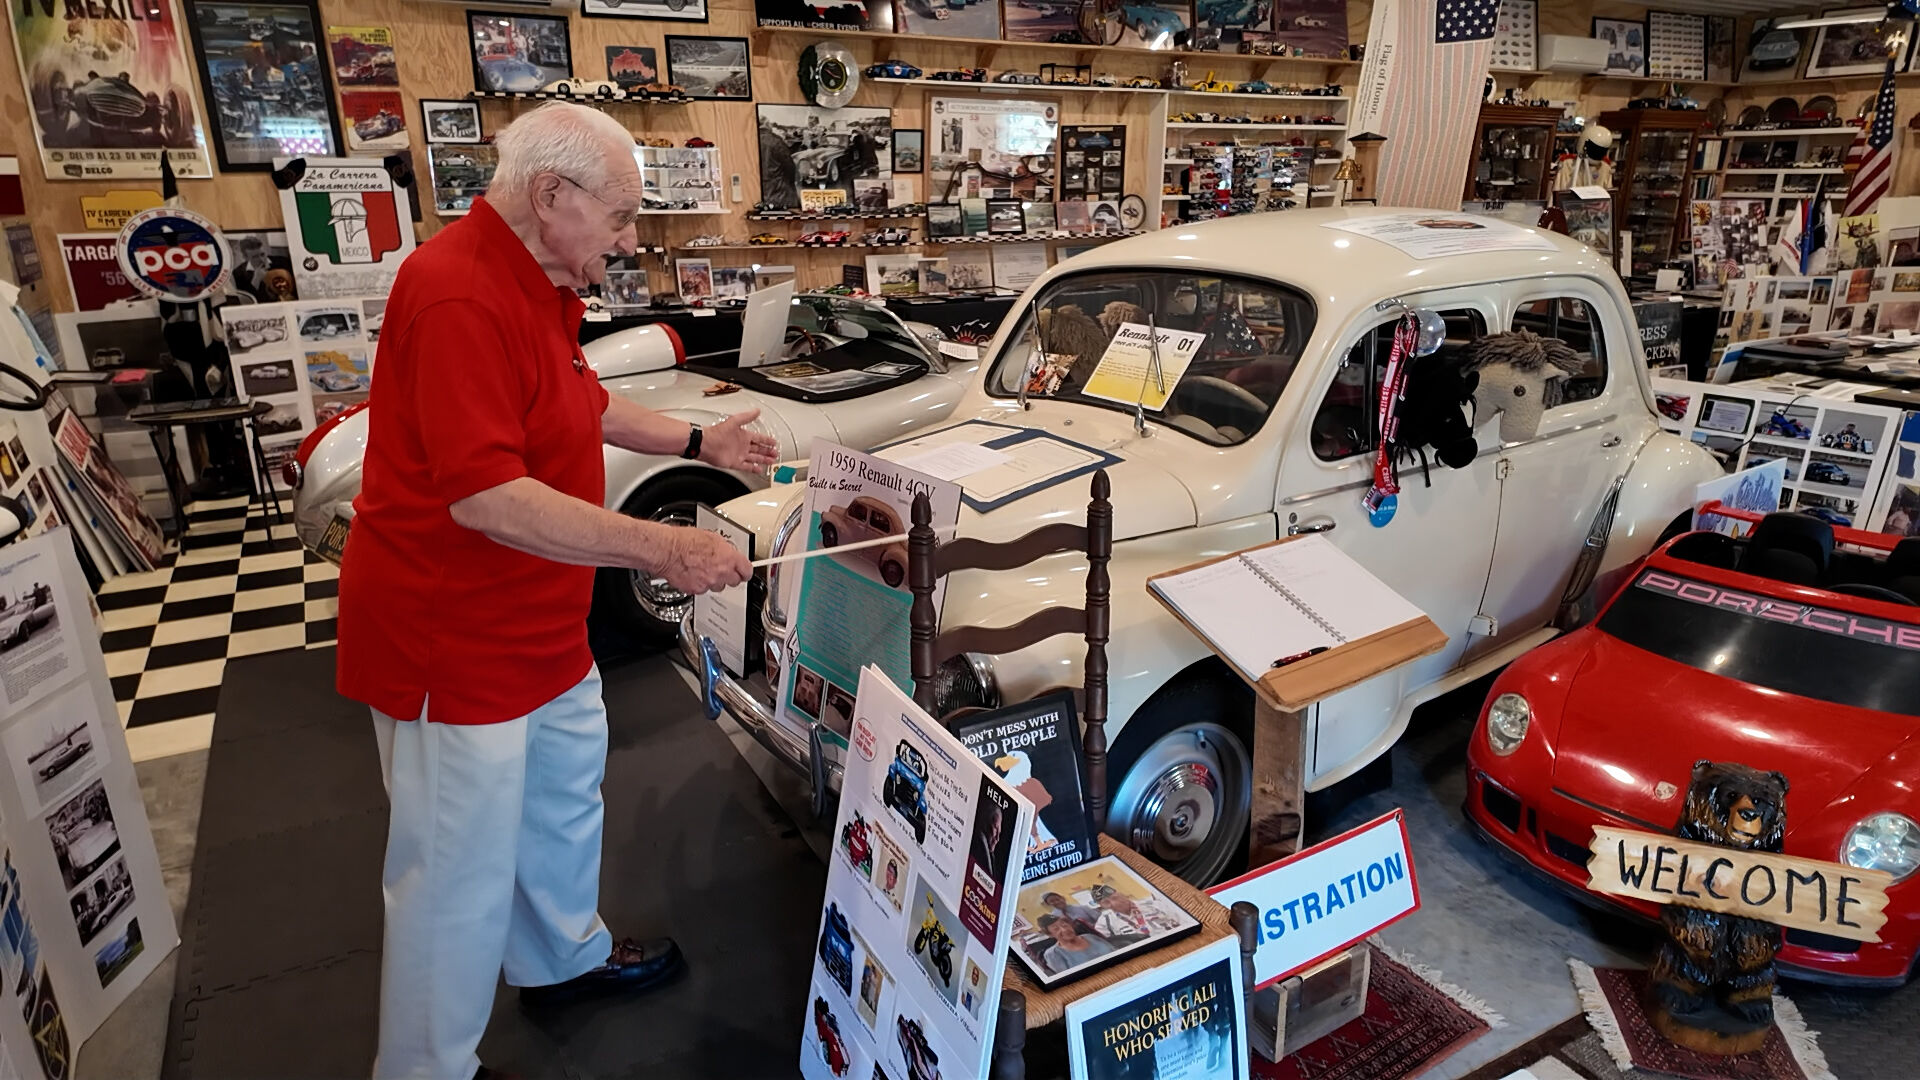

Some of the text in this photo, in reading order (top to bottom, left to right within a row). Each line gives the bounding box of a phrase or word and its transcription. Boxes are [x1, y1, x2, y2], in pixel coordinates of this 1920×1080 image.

[64, 0, 162, 22] MEXICO
[760, 18, 791, 27] SUPPORTS
[793, 20, 805, 28] ALL
[836, 23, 860, 31] EVENTS
[1379, 44, 1392, 66] Flag
[1378, 68, 1387, 79] of
[69, 152, 83, 160] DEL
[97, 152, 108, 160] AL
[302, 179, 385, 190] Panamericana
[305, 168, 379, 180] La Carrera
[64, 245, 118, 262] TARGA
[134, 244, 219, 277] pca
[341, 246, 370, 257] MEXICO
[1177, 337, 1195, 352] 01
[1639, 325, 1668, 341] RESS
[829, 450, 856, 474] 1959
[857, 460, 903, 493] Renault
[808, 476, 863, 493] Built in Secret
[1641, 573, 1920, 649] PORSCHE
[959, 711, 1060, 747] DON'T MESS WITH
[970, 724, 1058, 760] OLD PEOPLE
[986, 785, 1009, 810] HELP
[1035, 847, 1053, 863] GET
[1053, 839, 1076, 855] THIS
[1020, 863, 1049, 882] BEING
[1049, 851, 1083, 873] STUPID
[1617, 838, 1862, 929] WELCOME
[1257, 852, 1404, 946] ISTRATION
[1103, 981, 1217, 1048] HONORING ALL
[1114, 1005, 1210, 1062] WHO SERVED
